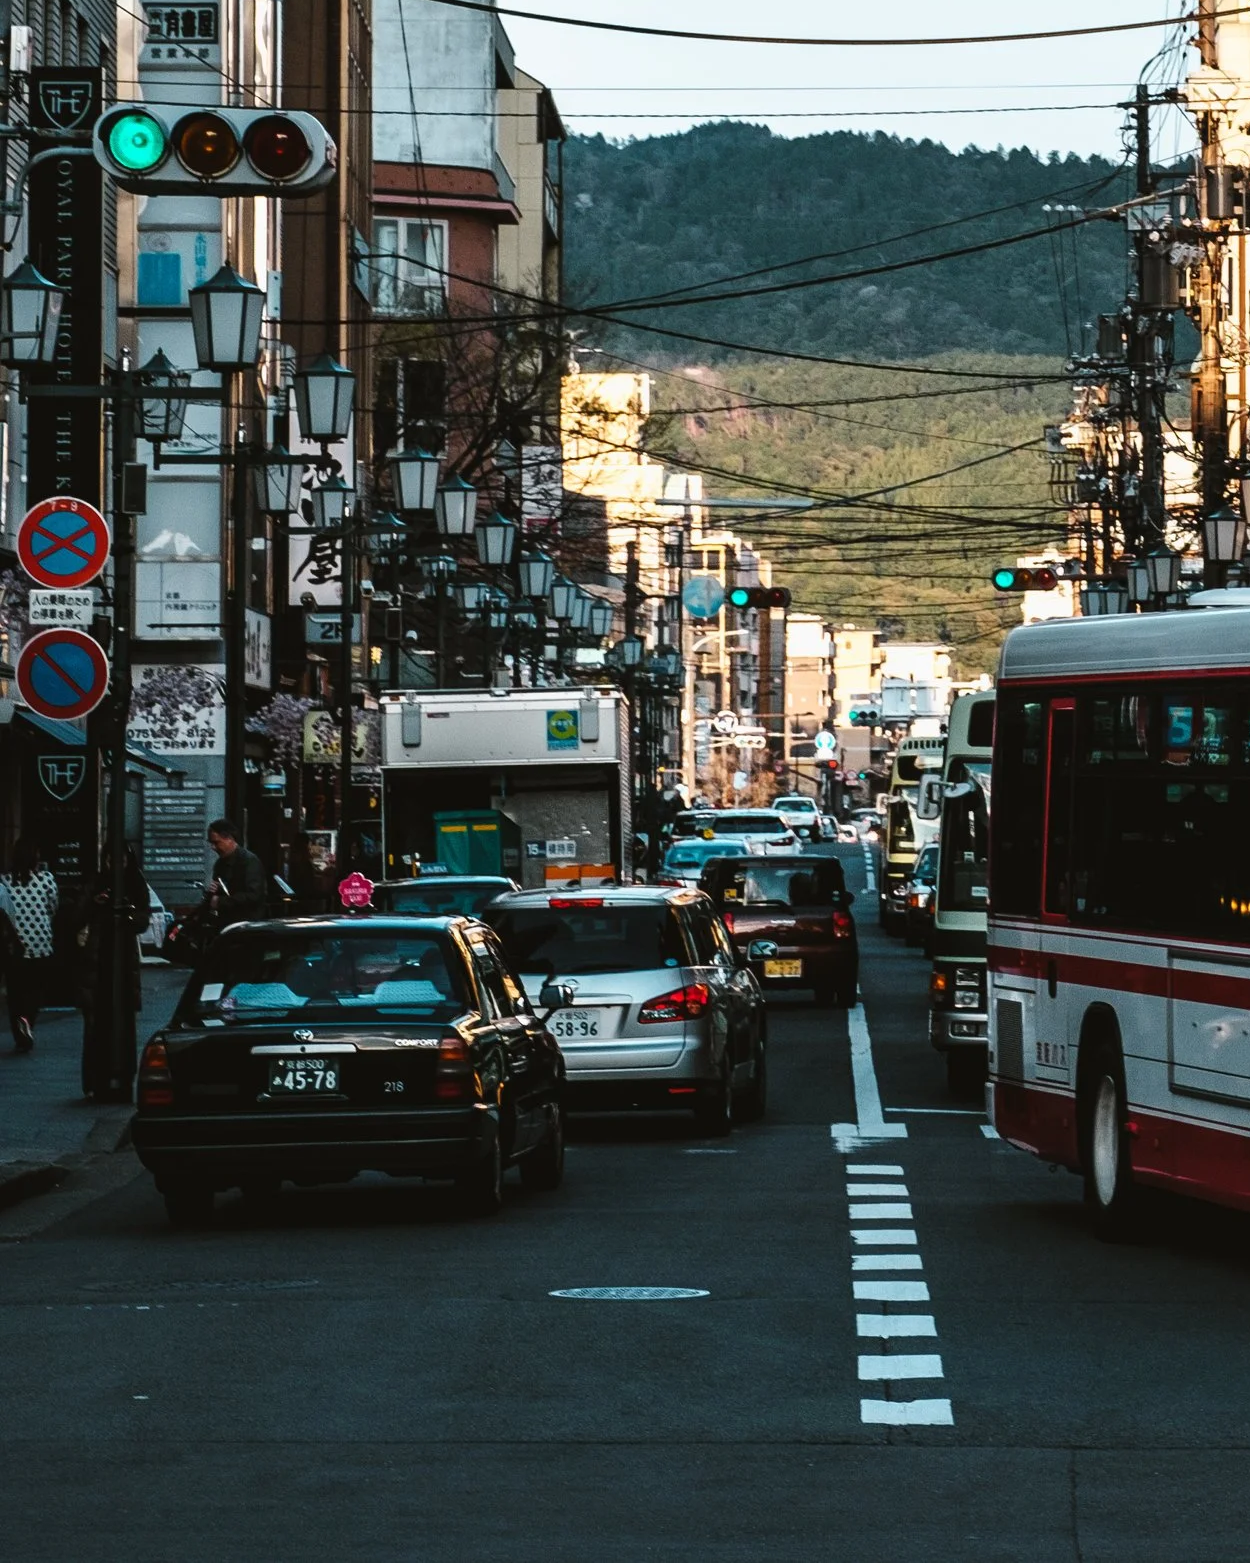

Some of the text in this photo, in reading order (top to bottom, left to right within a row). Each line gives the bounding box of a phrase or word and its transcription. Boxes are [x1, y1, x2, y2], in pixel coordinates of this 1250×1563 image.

[46, 89, 85, 114] THE
[57, 158, 73, 224] OYAL
[57, 314, 73, 383] HOTE
[32, 594, 91, 606] 人の乗降のため
[32, 608, 82, 620] の停車を除く
[44, 762, 81, 787] THE
[556, 1021, 598, 1037] 58-96
[394, 1038, 439, 1047] COMFORT
[284, 1070, 337, 1090] 45-78
[383, 1081, 405, 1094] 218
